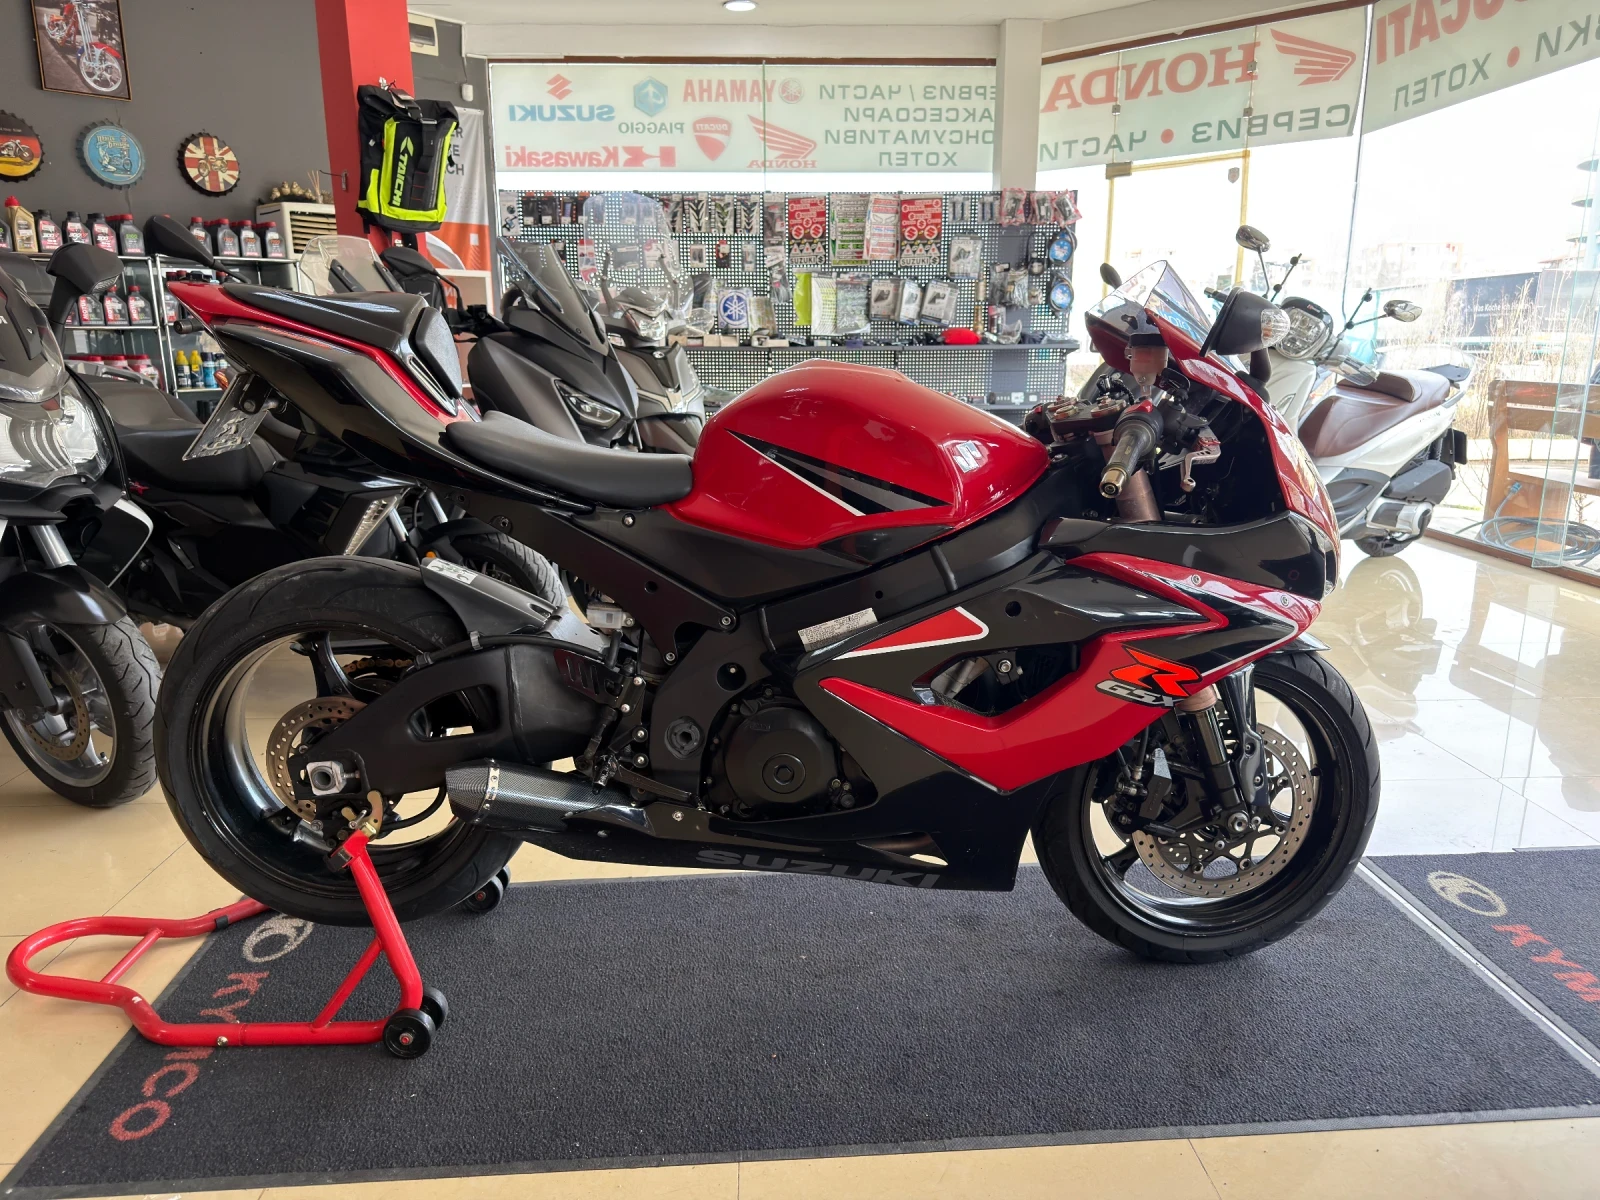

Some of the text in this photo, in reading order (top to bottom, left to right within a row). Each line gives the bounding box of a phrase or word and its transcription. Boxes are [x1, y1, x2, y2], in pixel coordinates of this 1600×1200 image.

[391, 154, 407, 207] TAICHI
[790, 257, 816, 265] SUZUKI
[695, 850, 941, 889] SUZUKI
[1491, 924, 1600, 1010] KYM
[109, 971, 269, 1141] KYCO
